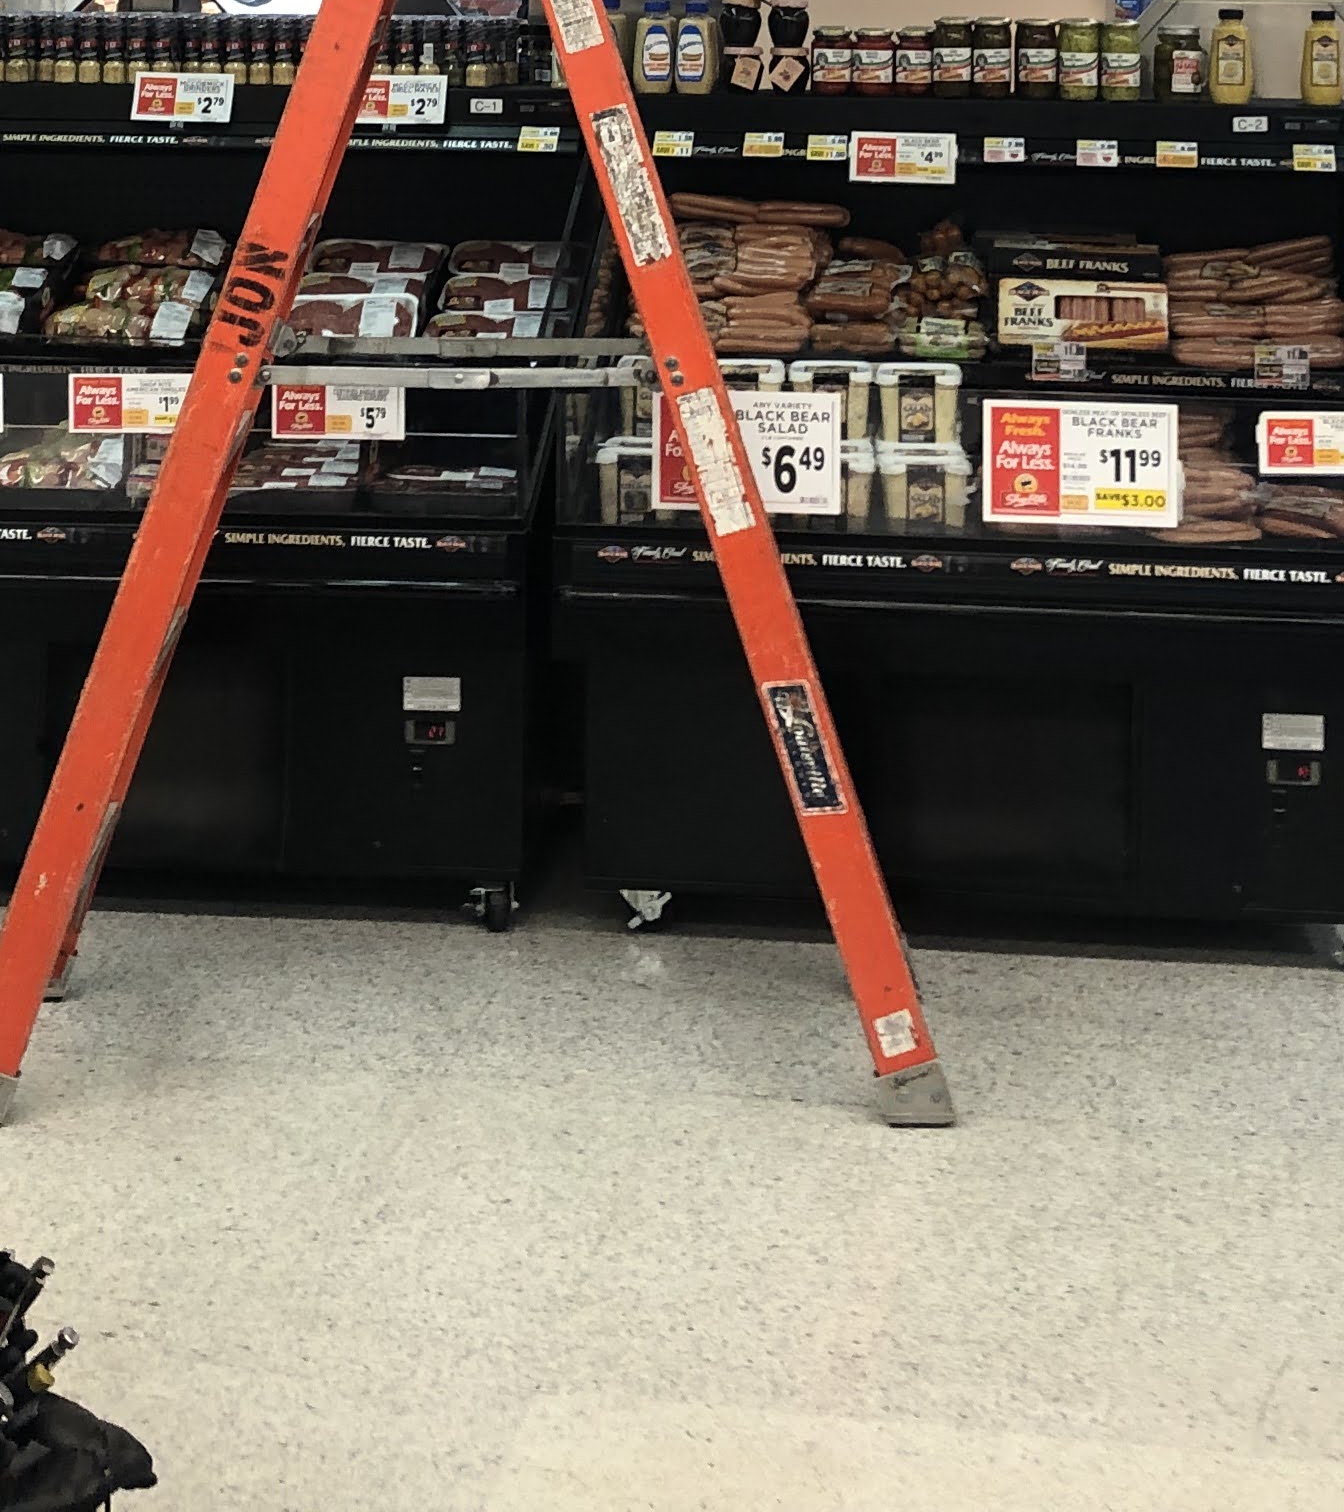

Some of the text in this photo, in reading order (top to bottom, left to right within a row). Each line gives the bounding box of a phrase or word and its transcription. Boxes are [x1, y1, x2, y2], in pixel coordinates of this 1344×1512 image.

[474, 102, 498, 111] C-1
[1237, 119, 1263, 130] C-2
[3, 134, 37, 142] SIMPLE
[443, 140, 477, 148] FIERCE
[1201, 158, 1237, 167] FIERCE
[1045, 259, 1129, 273] BEEF FRANKS
[1004, 308, 1053, 328] BEEF FRANKS
[79, 385, 117, 396] Always
[76, 395, 93, 404] For
[282, 392, 320, 401] Always
[279, 401, 295, 410] For
[736, 410, 830, 422] BLACK BEAR
[1001, 413, 1050, 425] Always
[1072, 417, 1157, 428] BLACK BEAR
[758, 423, 808, 434] SALAD
[1005, 424, 1046, 436] Fresh.
[1088, 428, 1142, 439] FRANKS
[1000, 441, 1052, 456] Always
[996, 456, 1018, 469] For
[1022, 456, 1055, 470] Less.
[1122, 495, 1166, 507] $3.00
[225, 532, 432, 549] SIMPLE INGREDIENTS, FIERCE TASTE.
[822, 555, 907, 569] FIERCE TASTE.
[1108, 563, 1151, 576] SIMPLE
[1154, 565, 1238, 580] INGREDIENTS,
[1243, 569, 1286, 582] FIERCE
[1289, 570, 1332, 584] TASTE.
